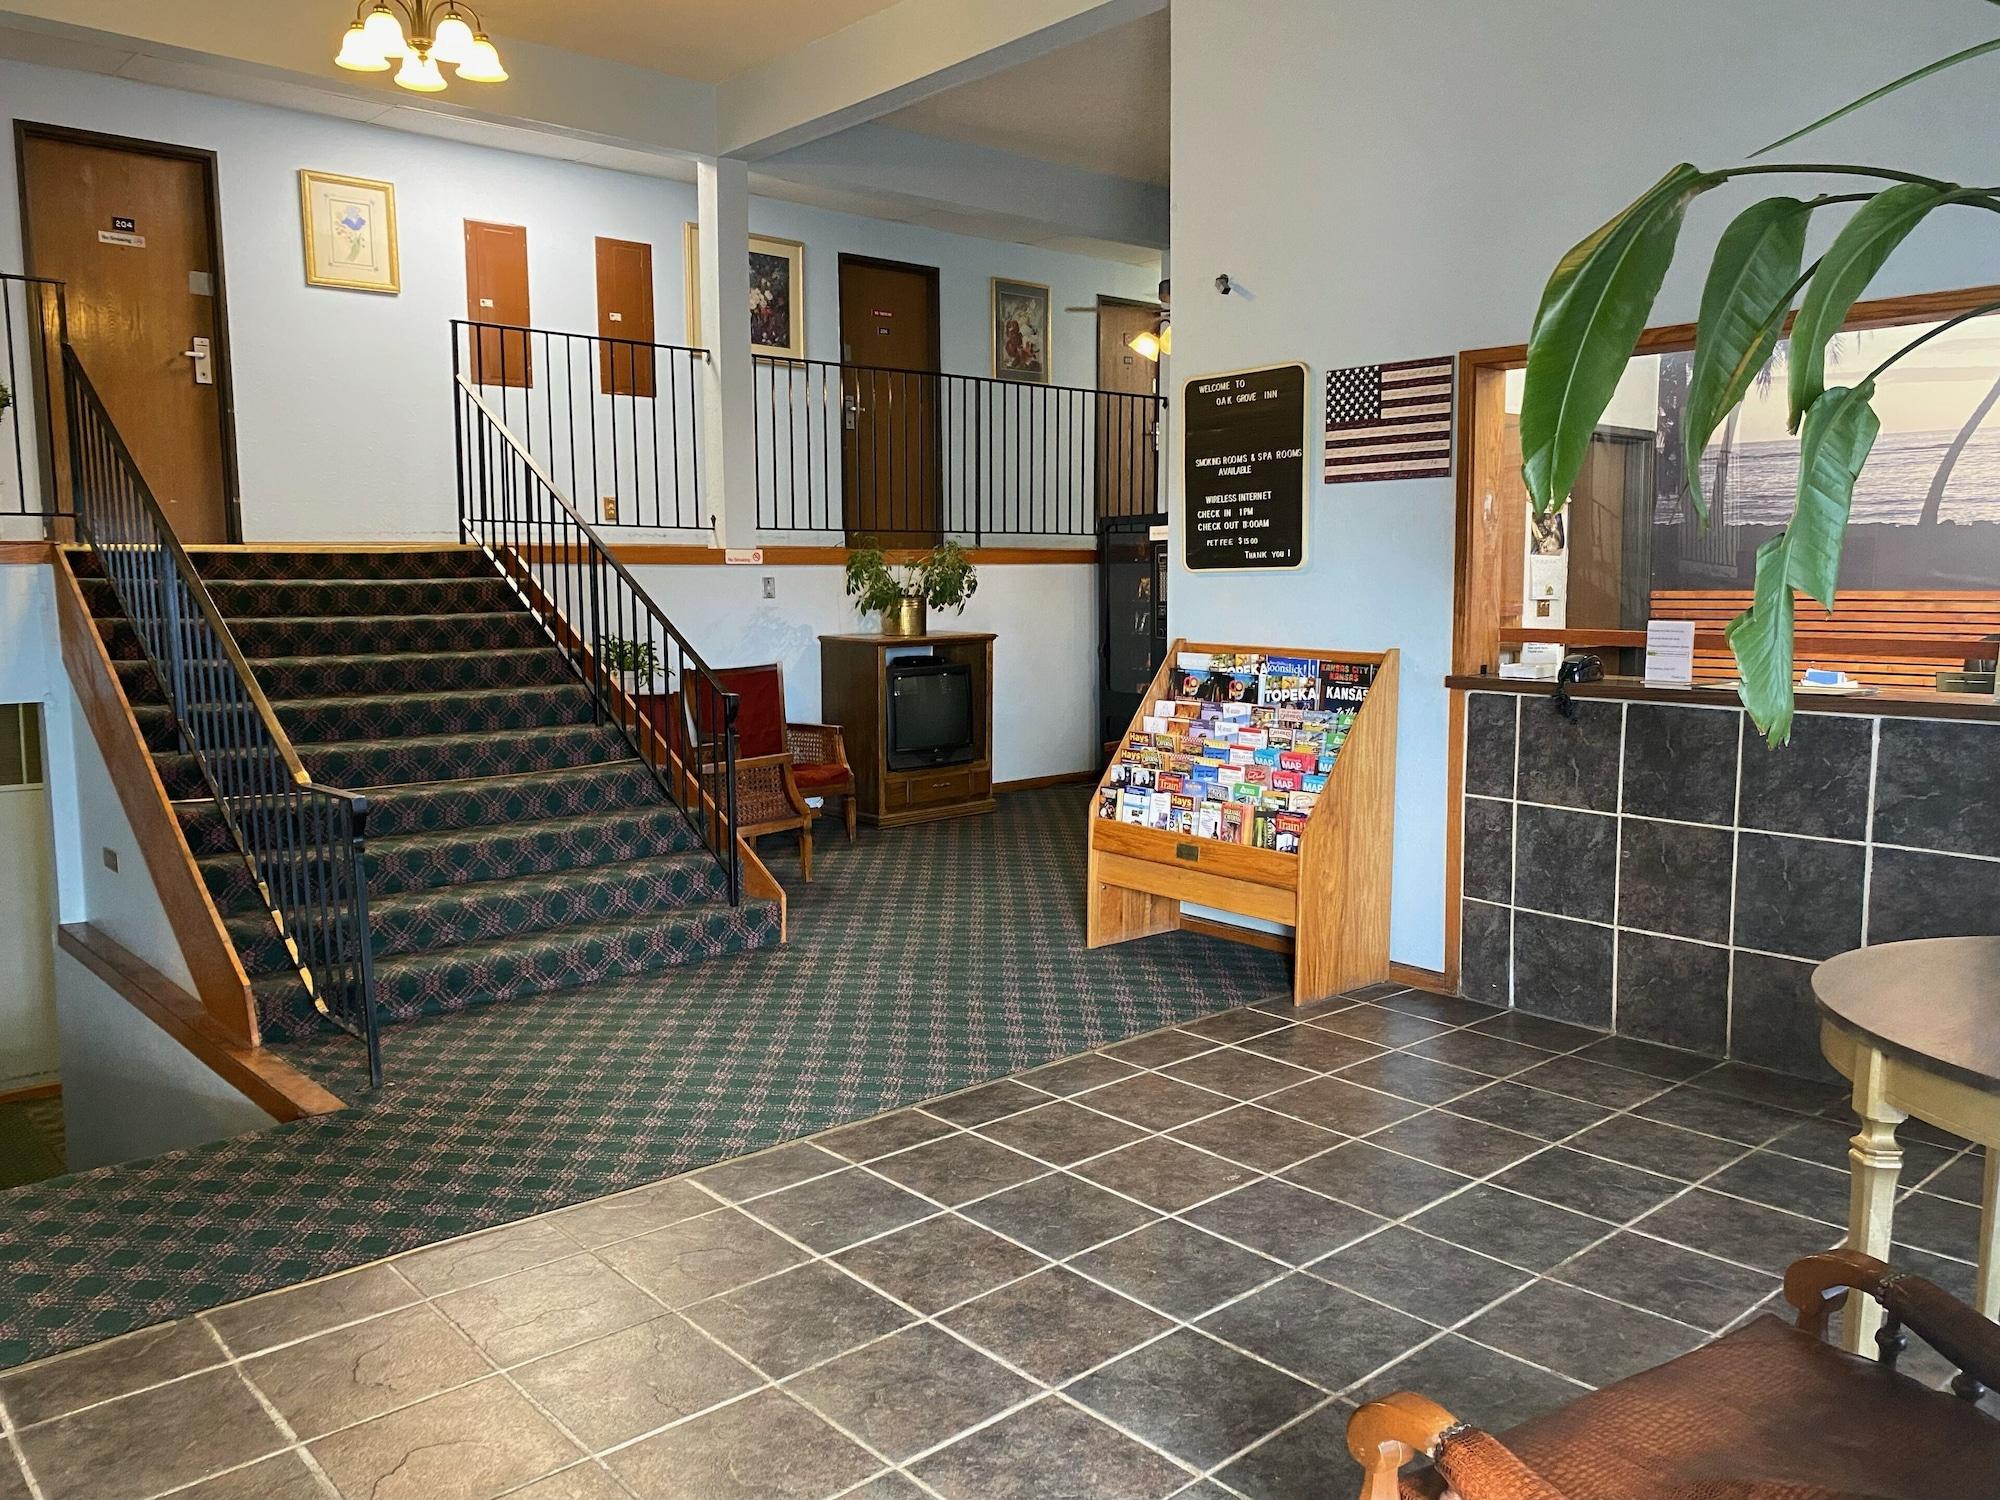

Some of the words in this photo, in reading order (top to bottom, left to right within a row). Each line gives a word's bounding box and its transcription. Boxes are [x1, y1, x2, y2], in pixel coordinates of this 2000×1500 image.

[115, 219, 133, 228] 204
[1199, 381, 1230, 394] WELCOME
[1235, 379, 1246, 388] TO
[1215, 396, 1232, 406] OAK
[1236, 392, 1257, 404] GROVE
[1264, 389, 1278, 399] INN
[1195, 457, 1221, 468] SMOKING
[1222, 454, 1248, 465] ROOMS
[1250, 453, 1256, 462] &
[1257, 451, 1272, 461] SPA
[1276, 448, 1303, 459] ROOMS
[1218, 465, 1252, 476] AVAILABLE
[1205, 493, 1237, 504] WIRELESS
[1238, 490, 1272, 502] INTERNET
[1197, 509, 1220, 519] CHECK
[1223, 508, 1231, 517] IN
[1197, 522, 1221, 532] CHECK
[1223, 521, 1239, 530] OUT
[1206, 539, 1218, 547] PET
[1219, 538, 1233, 547] FEE
[1245, 550, 1267, 559] THANK
[1271, 550, 1285, 558] YOU
[1320, 663, 1350, 673] KANSAS
[1352, 666, 1369, 674] CITY
[1328, 672, 1359, 682] KANSAS
[1265, 687, 1316, 702] TOPEKA
[1130, 732, 1149, 743] Hays
[1121, 749, 1141, 760] Hays
[1255, 756, 1274, 766] MAP
[1281, 760, 1302, 770] MAP
[1160, 779, 1179, 791] Train!
[1273, 778, 1294, 789] MAP
[1302, 782, 1324, 793] MAP
[1171, 794, 1192, 806] Hays
[1279, 818, 1303, 831] Train!
